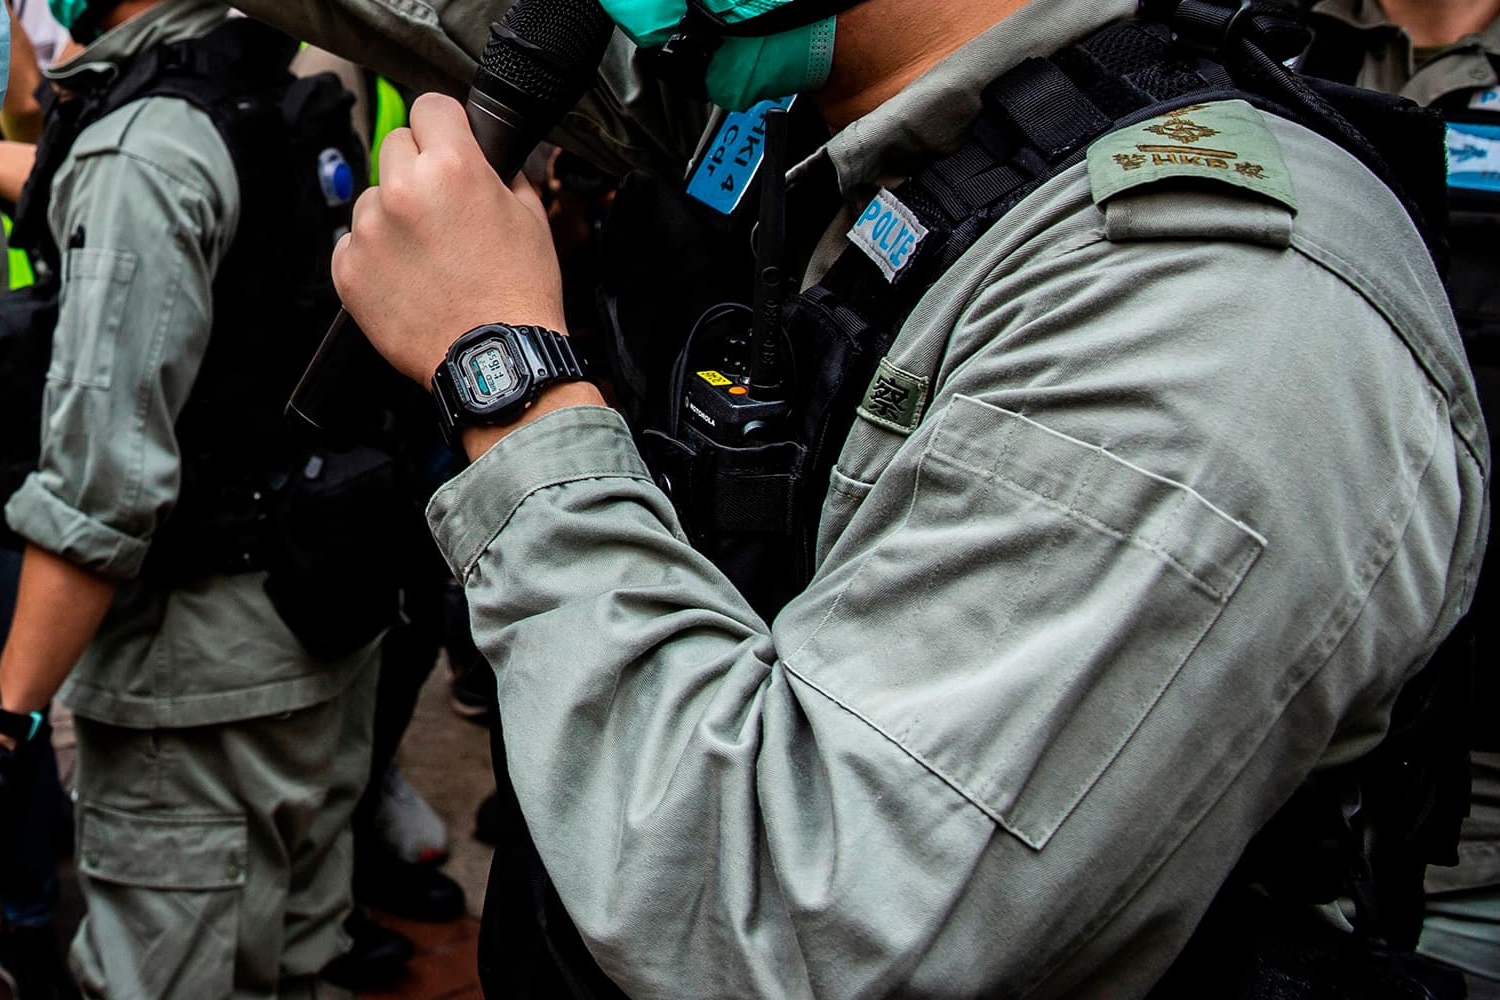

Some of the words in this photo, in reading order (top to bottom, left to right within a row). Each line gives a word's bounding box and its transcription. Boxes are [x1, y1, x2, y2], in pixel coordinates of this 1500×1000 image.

[706, 124, 739, 177] Cdr
[734, 113, 766, 168] HKI
[721, 173, 734, 192] 4
